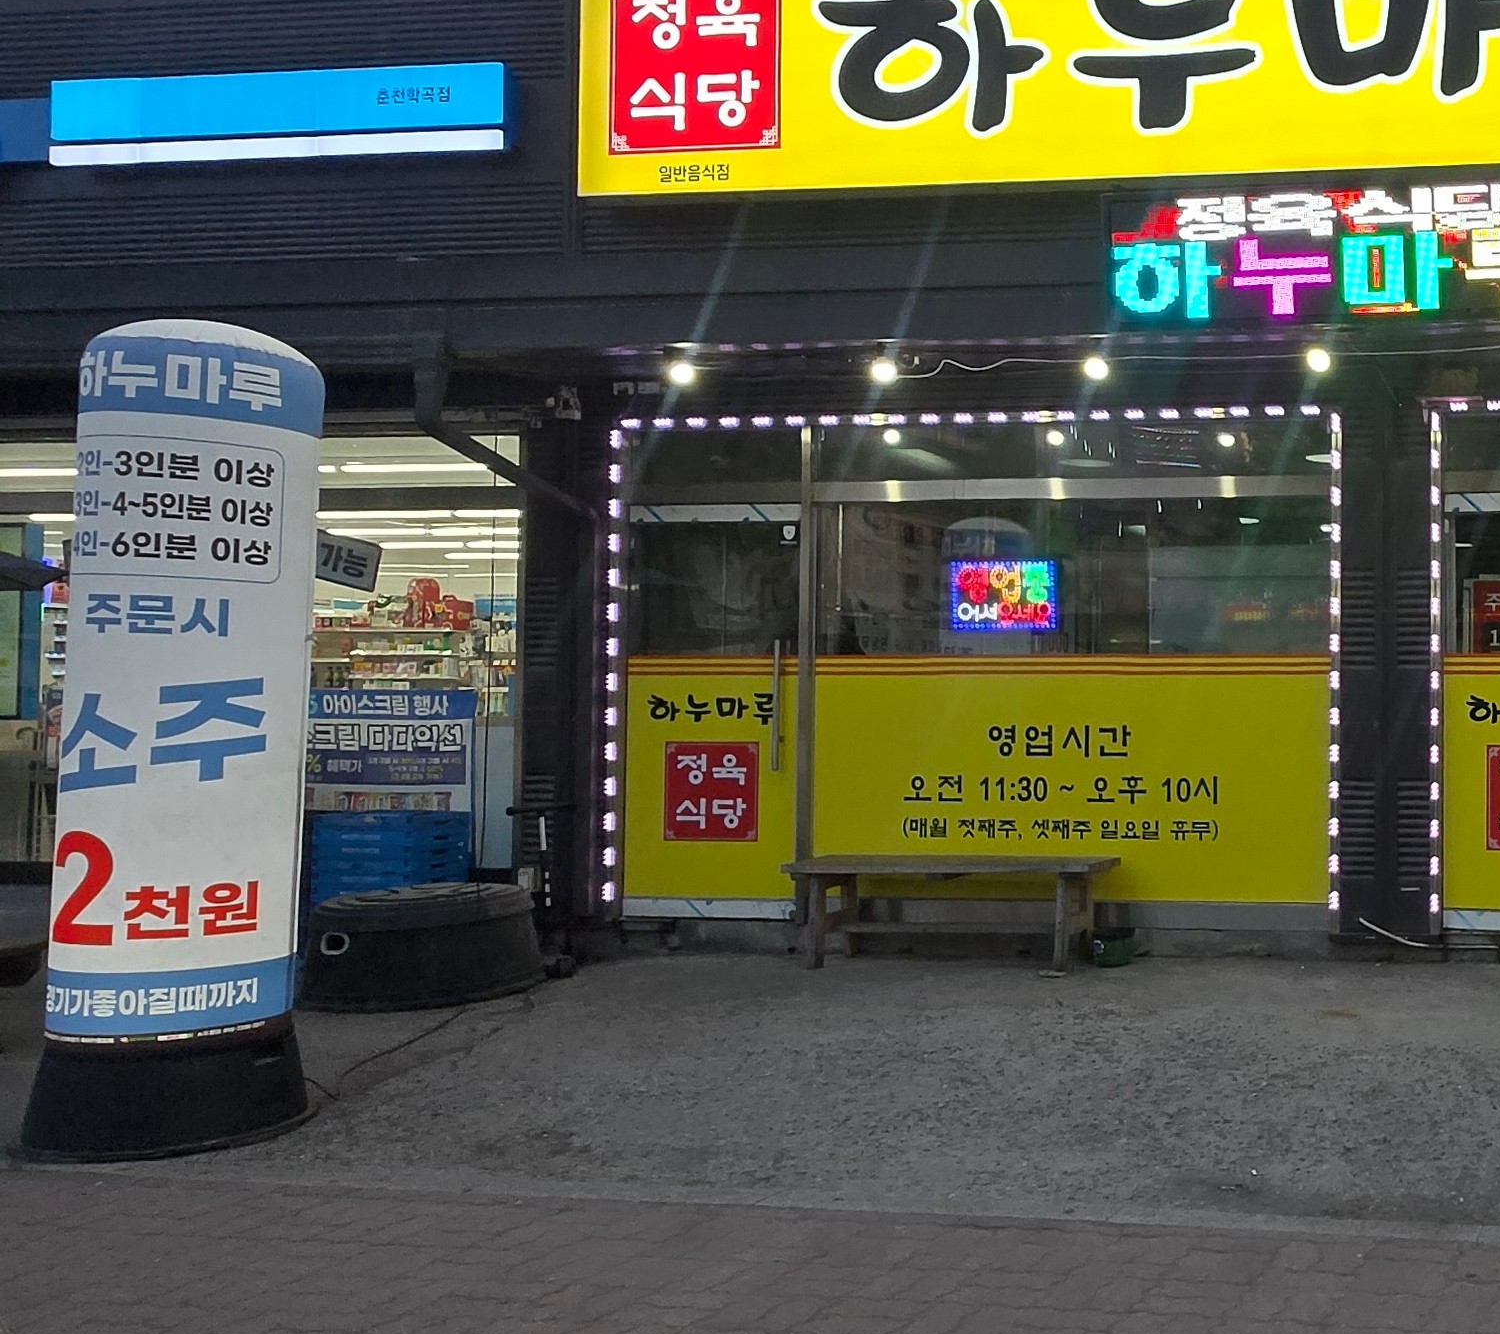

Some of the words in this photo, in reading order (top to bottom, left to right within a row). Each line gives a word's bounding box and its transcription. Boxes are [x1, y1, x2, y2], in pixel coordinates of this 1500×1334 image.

[376, 85, 450, 105] 춘천학곡점
[629, 69, 761, 132] 식당
[658, 163, 730, 183] 일반음식점
[79, 350, 283, 411] 하누마루
[213, 457, 275, 488] 이상
[221, 498, 273, 527] 이상
[210, 537, 272, 566] 이상
[319, 541, 368, 578] 가능
[84, 593, 230, 637] 주문시
[322, 694, 409, 716] 아이스크림
[413, 694, 449, 716] 행사
[647, 692, 774, 726] 하누마루
[59, 677, 267, 794] 소주
[367, 723, 464, 753] 다다익선
[988, 724, 1132, 758] 영업시간
[677, 753, 748, 786] 정육
[903, 774, 963, 803] 오전
[979, 776, 1048, 802] 11:30
[1086, 775, 1148, 805] 오후
[1161, 775, 1218, 805] 10시
[675, 797, 747, 830] 식당
[902, 817, 948, 839] (매월
[1031, 818, 1093, 840] 셋째주
[1100, 819, 1160, 840] 일요일
[1170, 818, 1219, 842] 휴무)
[51, 829, 260, 947] 2천원
